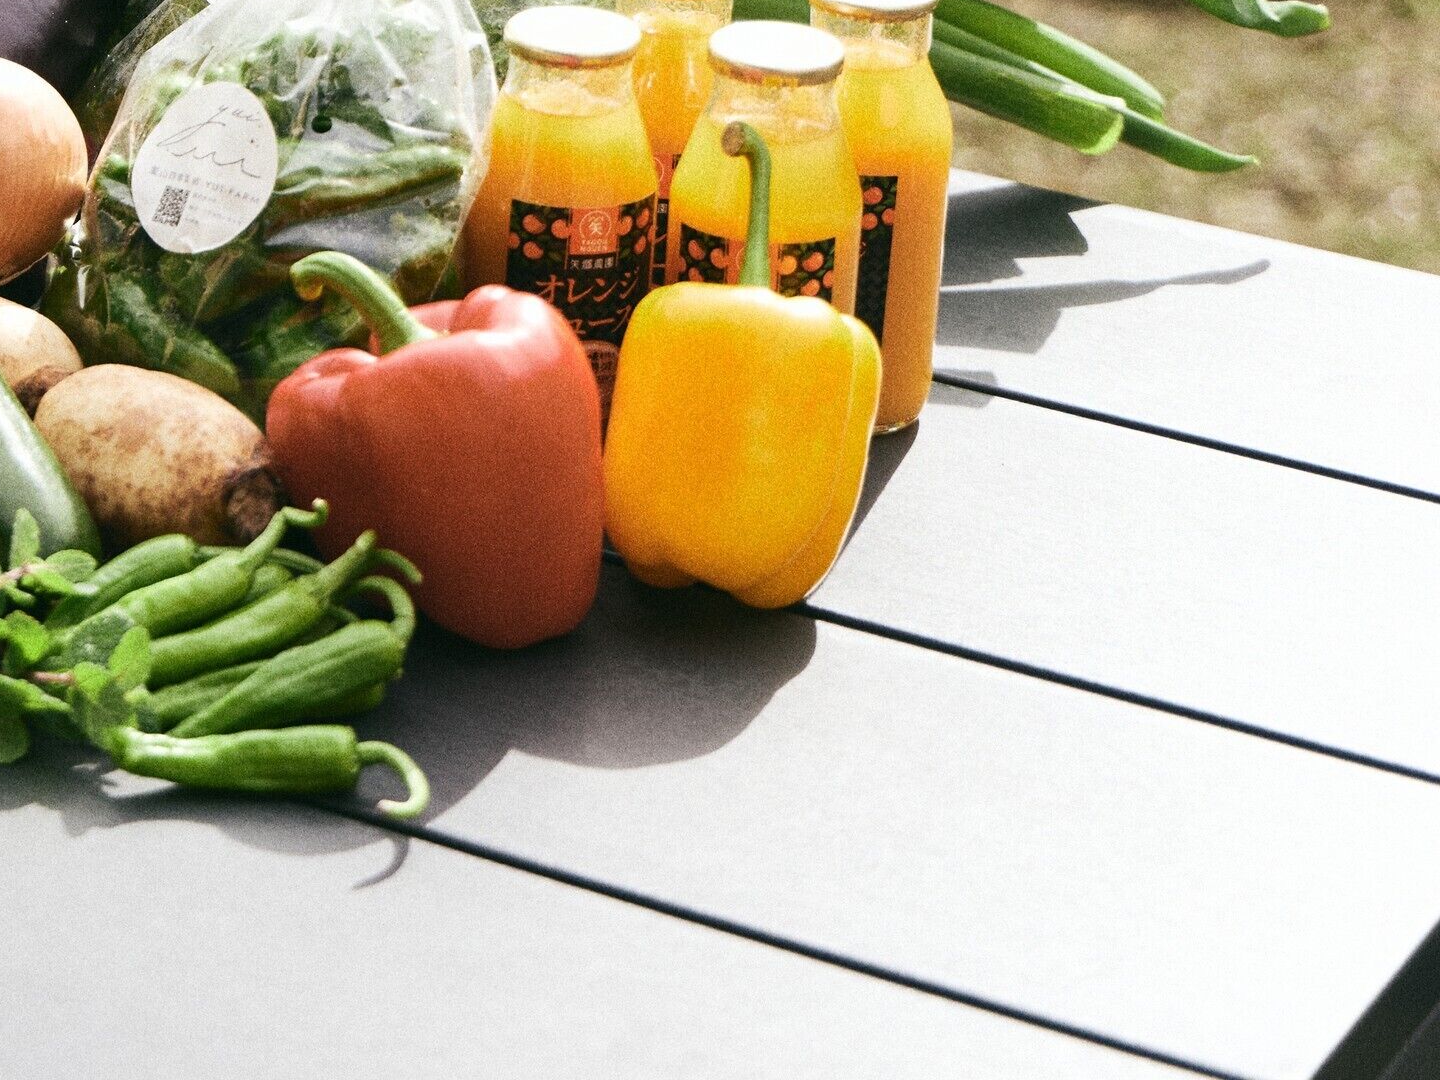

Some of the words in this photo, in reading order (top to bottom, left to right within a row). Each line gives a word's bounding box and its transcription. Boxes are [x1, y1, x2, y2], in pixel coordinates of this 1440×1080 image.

[535, 266, 639, 304] オレンジ
[570, 304, 633, 335] ュース
